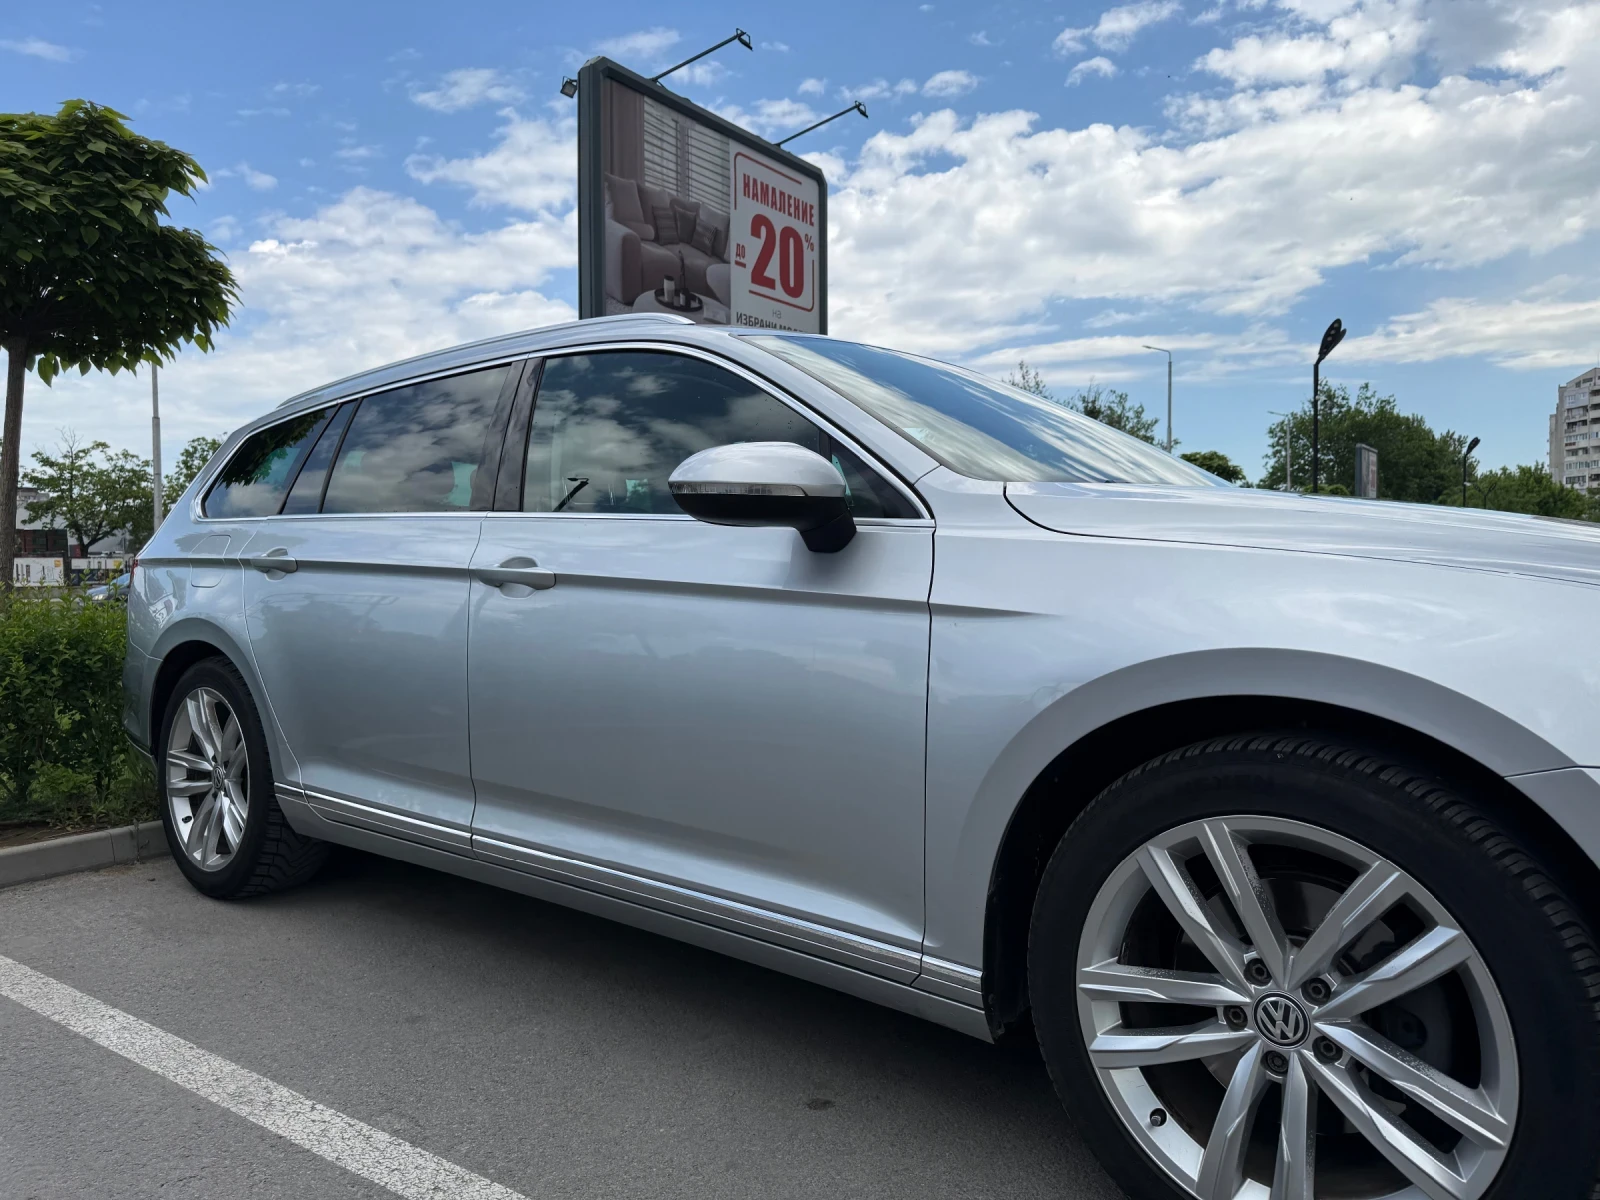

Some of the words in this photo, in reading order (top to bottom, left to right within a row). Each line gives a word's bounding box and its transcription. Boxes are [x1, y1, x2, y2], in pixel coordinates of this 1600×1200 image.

[743, 173, 814, 227] НАМАЛЕНИЕ
[736, 243, 746, 260] ДО
[772, 309, 782, 319] на
